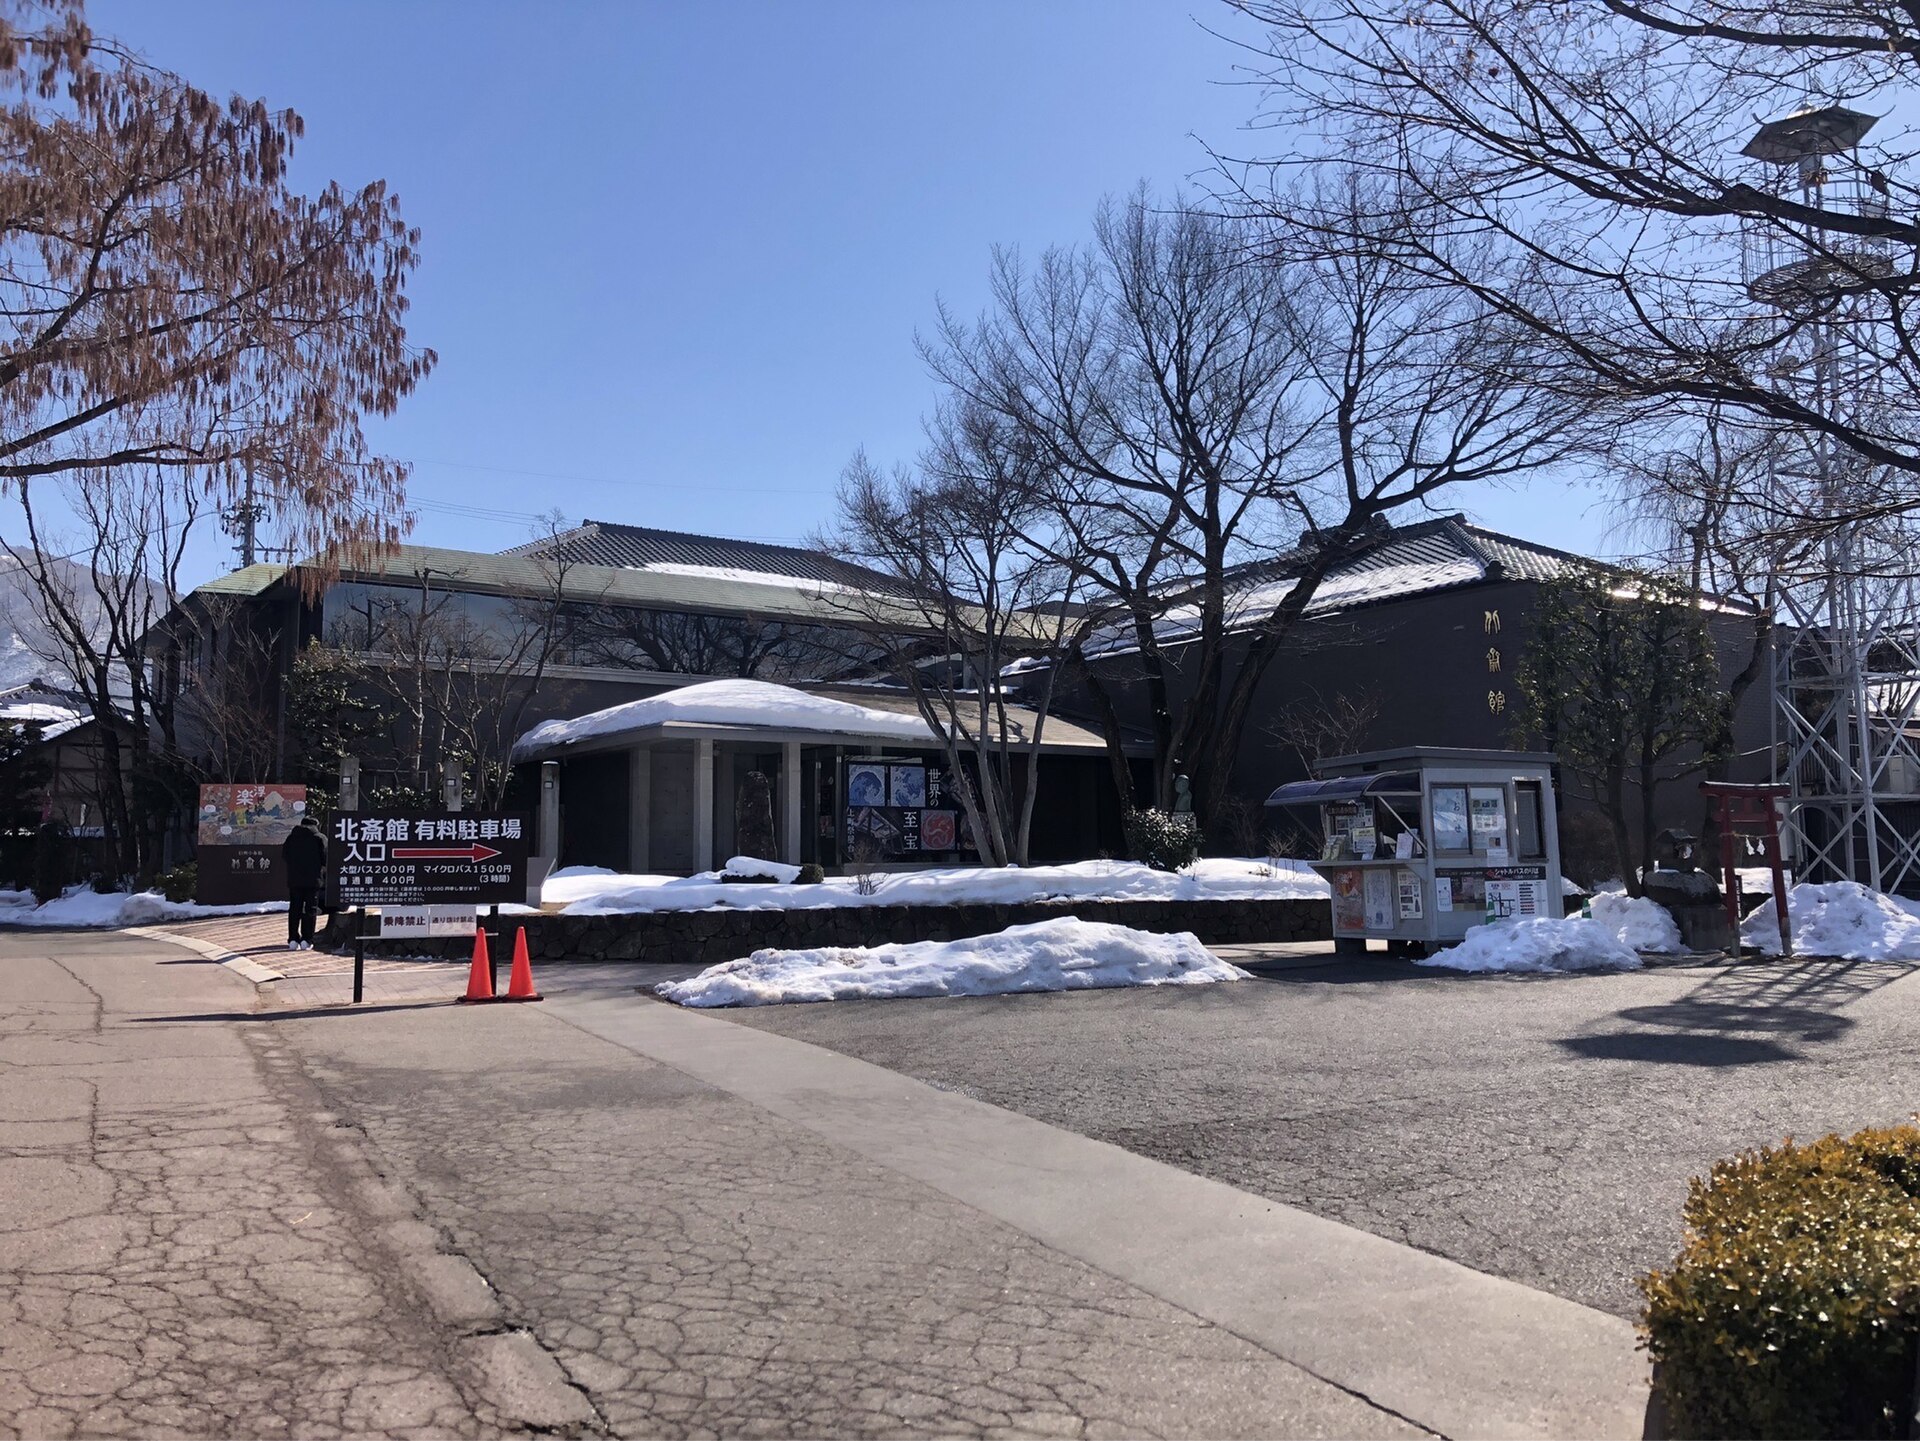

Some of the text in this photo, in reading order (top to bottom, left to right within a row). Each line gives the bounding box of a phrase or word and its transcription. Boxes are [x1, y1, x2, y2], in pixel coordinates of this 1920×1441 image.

[236, 789, 254, 806] 楽
[928, 768, 942, 807] 世界の
[335, 818, 522, 842] 北斎館 有料駐車場
[903, 811, 918, 850] 至宝
[343, 843, 386, 862] 入口
[383, 916, 475, 927] 乗降禁止 通り抜け禁止
